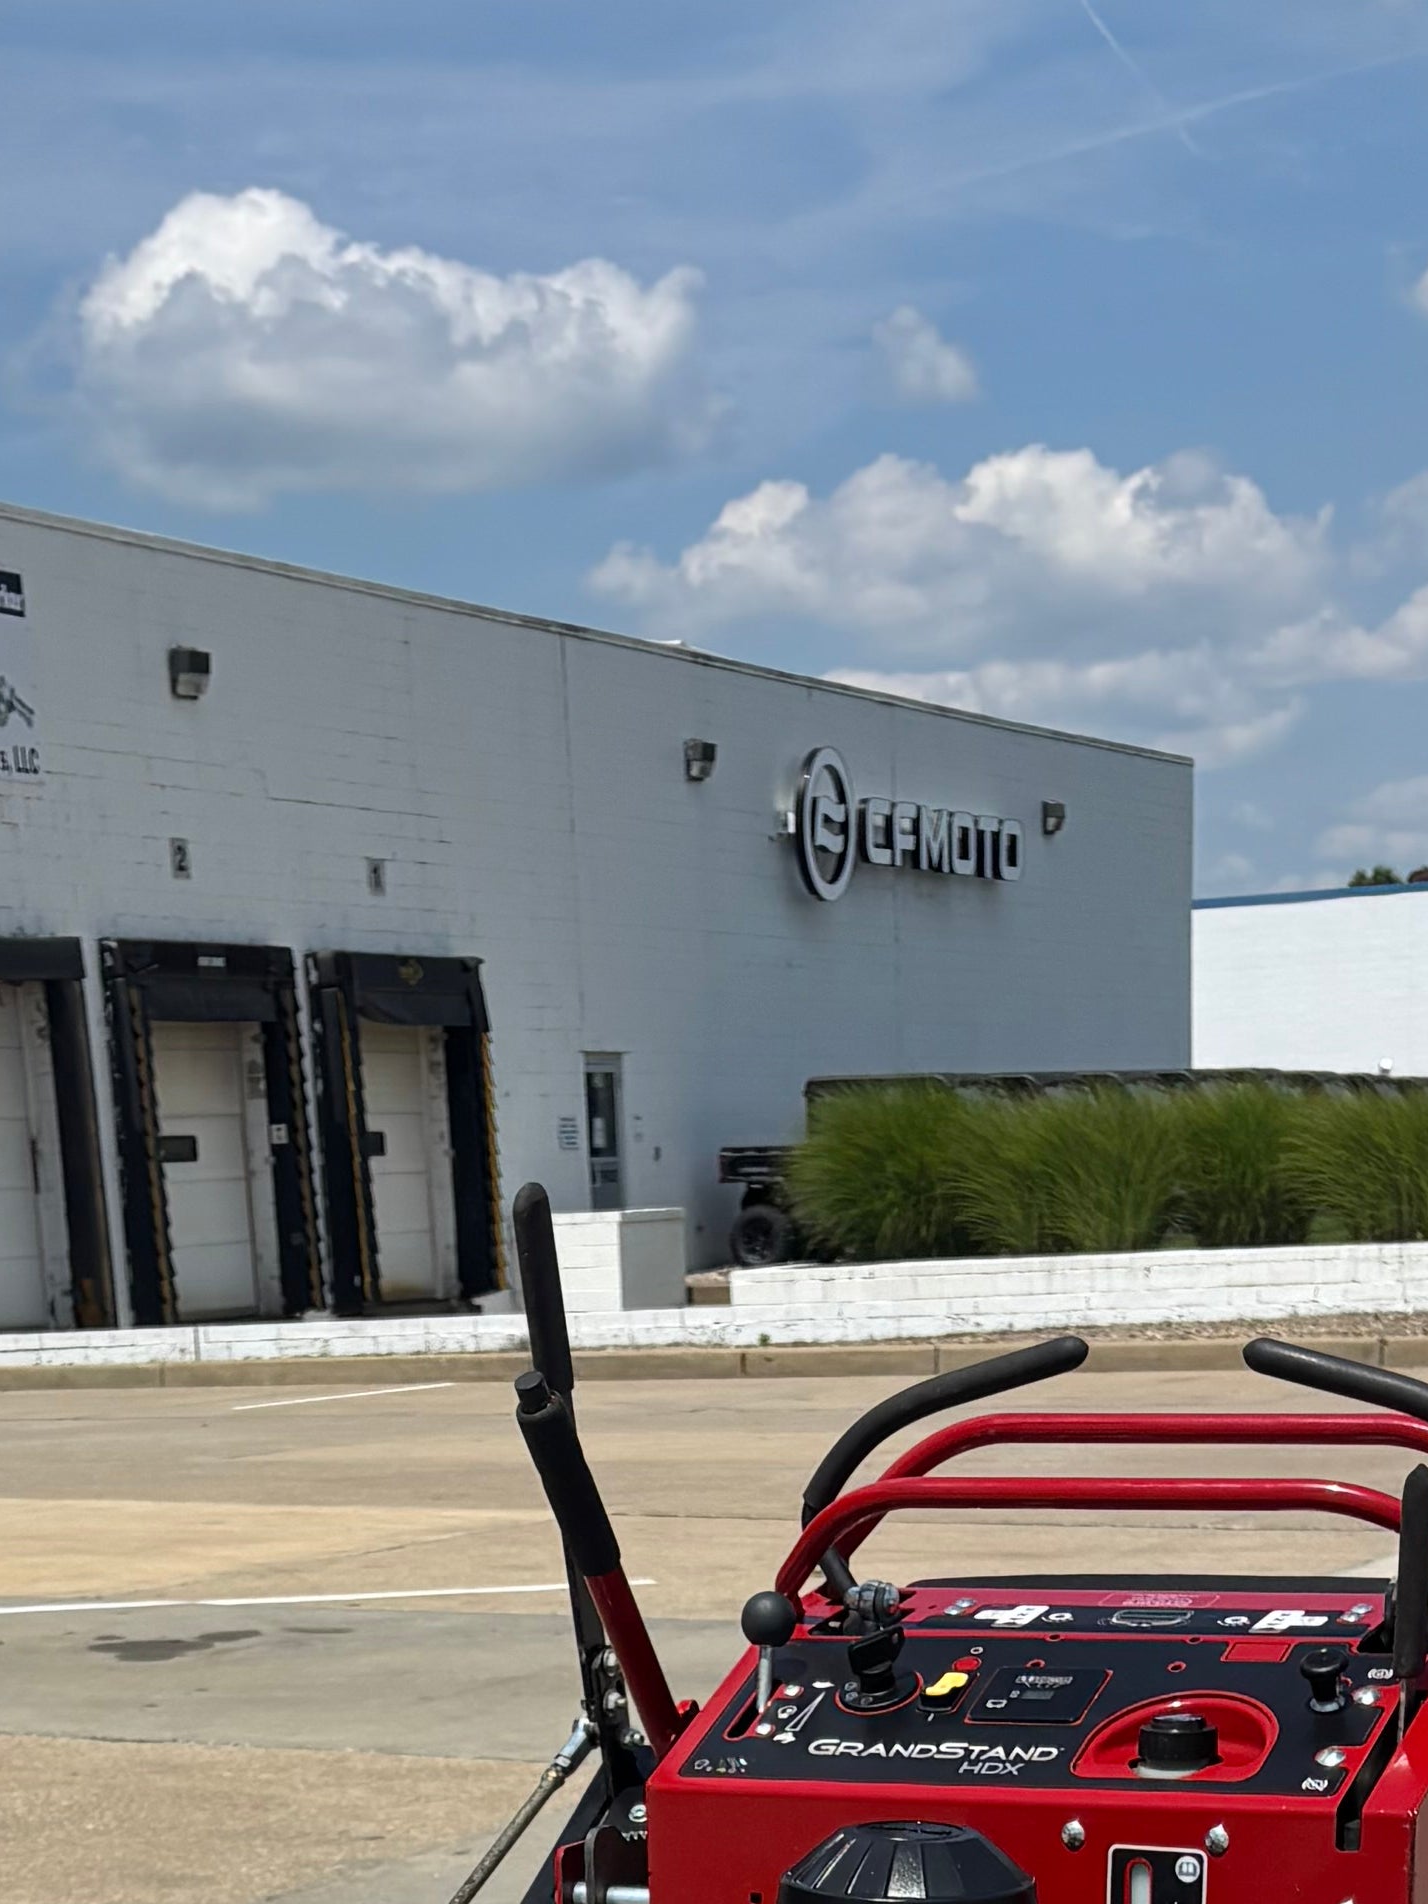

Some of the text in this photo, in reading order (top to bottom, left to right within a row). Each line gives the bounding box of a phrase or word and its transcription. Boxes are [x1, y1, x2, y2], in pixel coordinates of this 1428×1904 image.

[12, 744, 40, 775] LLC
[863, 796, 1022, 882] CFMOTO
[174, 844, 189, 873] 2
[958, 1760, 1025, 1776] HDX
